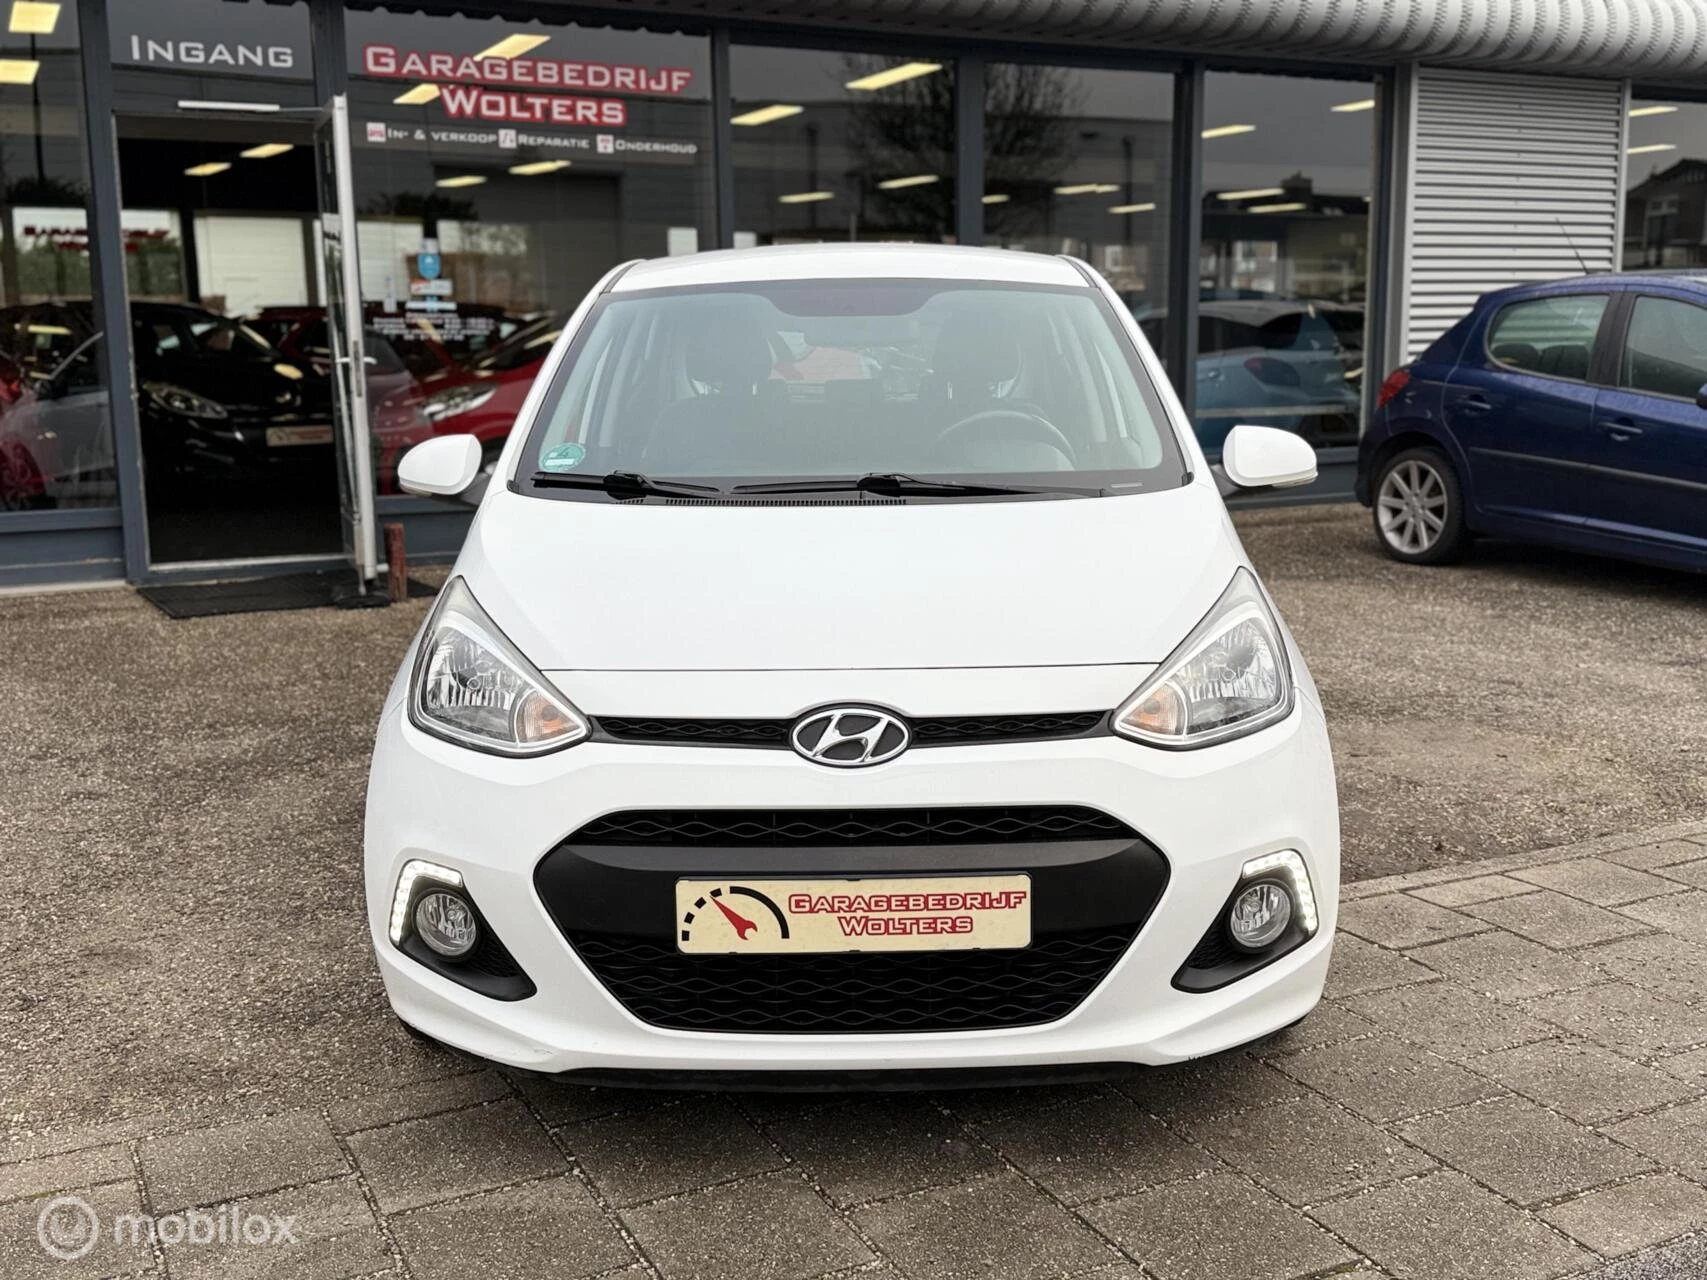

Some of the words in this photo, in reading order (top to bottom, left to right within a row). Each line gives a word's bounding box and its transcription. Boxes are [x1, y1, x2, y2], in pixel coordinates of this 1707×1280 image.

[131, 34, 294, 68] INGANG
[364, 45, 692, 92] GARAGEBEDRIJF
[440, 87, 626, 125] WOLTERS
[414, 129, 427, 141] &
[788, 890, 1028, 914] GARAGEBEDRIJF
[836, 915, 974, 937] WOLTERS
